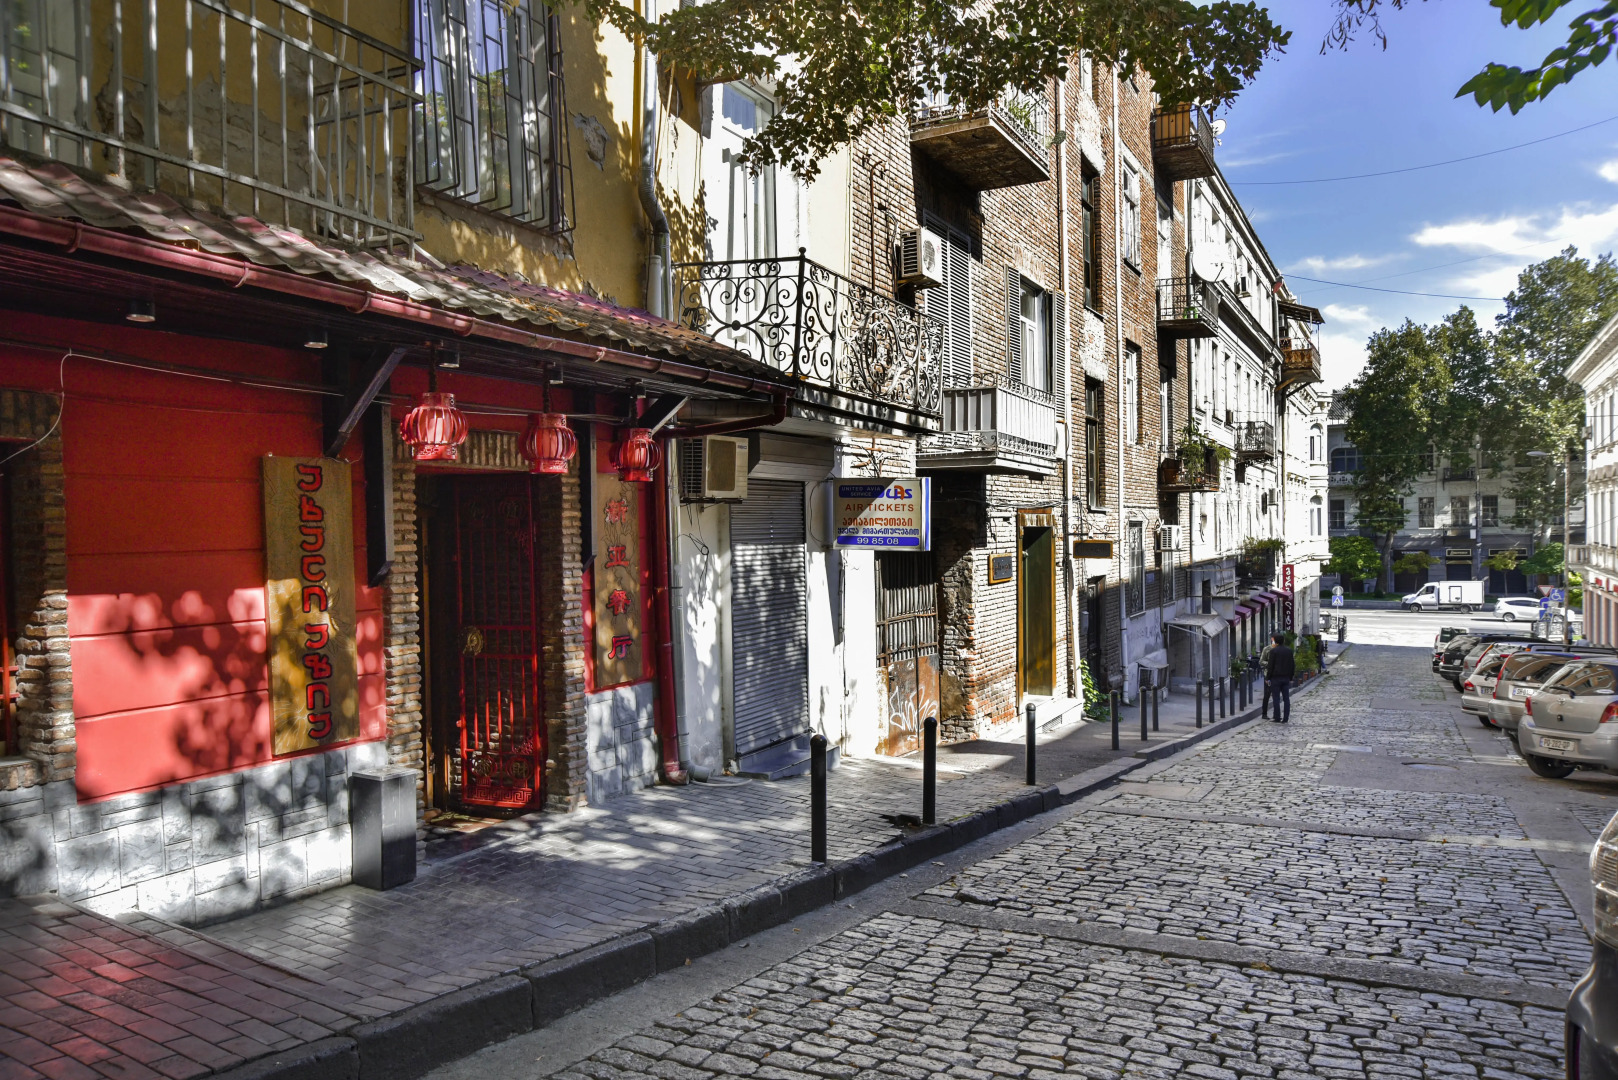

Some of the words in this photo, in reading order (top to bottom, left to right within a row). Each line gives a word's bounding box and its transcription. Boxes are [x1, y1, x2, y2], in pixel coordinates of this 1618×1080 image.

[845, 503, 864, 512] AIR
[868, 503, 914, 512] TICKETS
[842, 517, 913, 527] ავიაბილეთები
[837, 527, 860, 535] ყველა
[862, 528, 920, 536] მიმართულებით
[857, 537, 869, 545] 99
[871, 537, 884, 545] 85
[604, 498, 633, 661] 新亚餐厅
